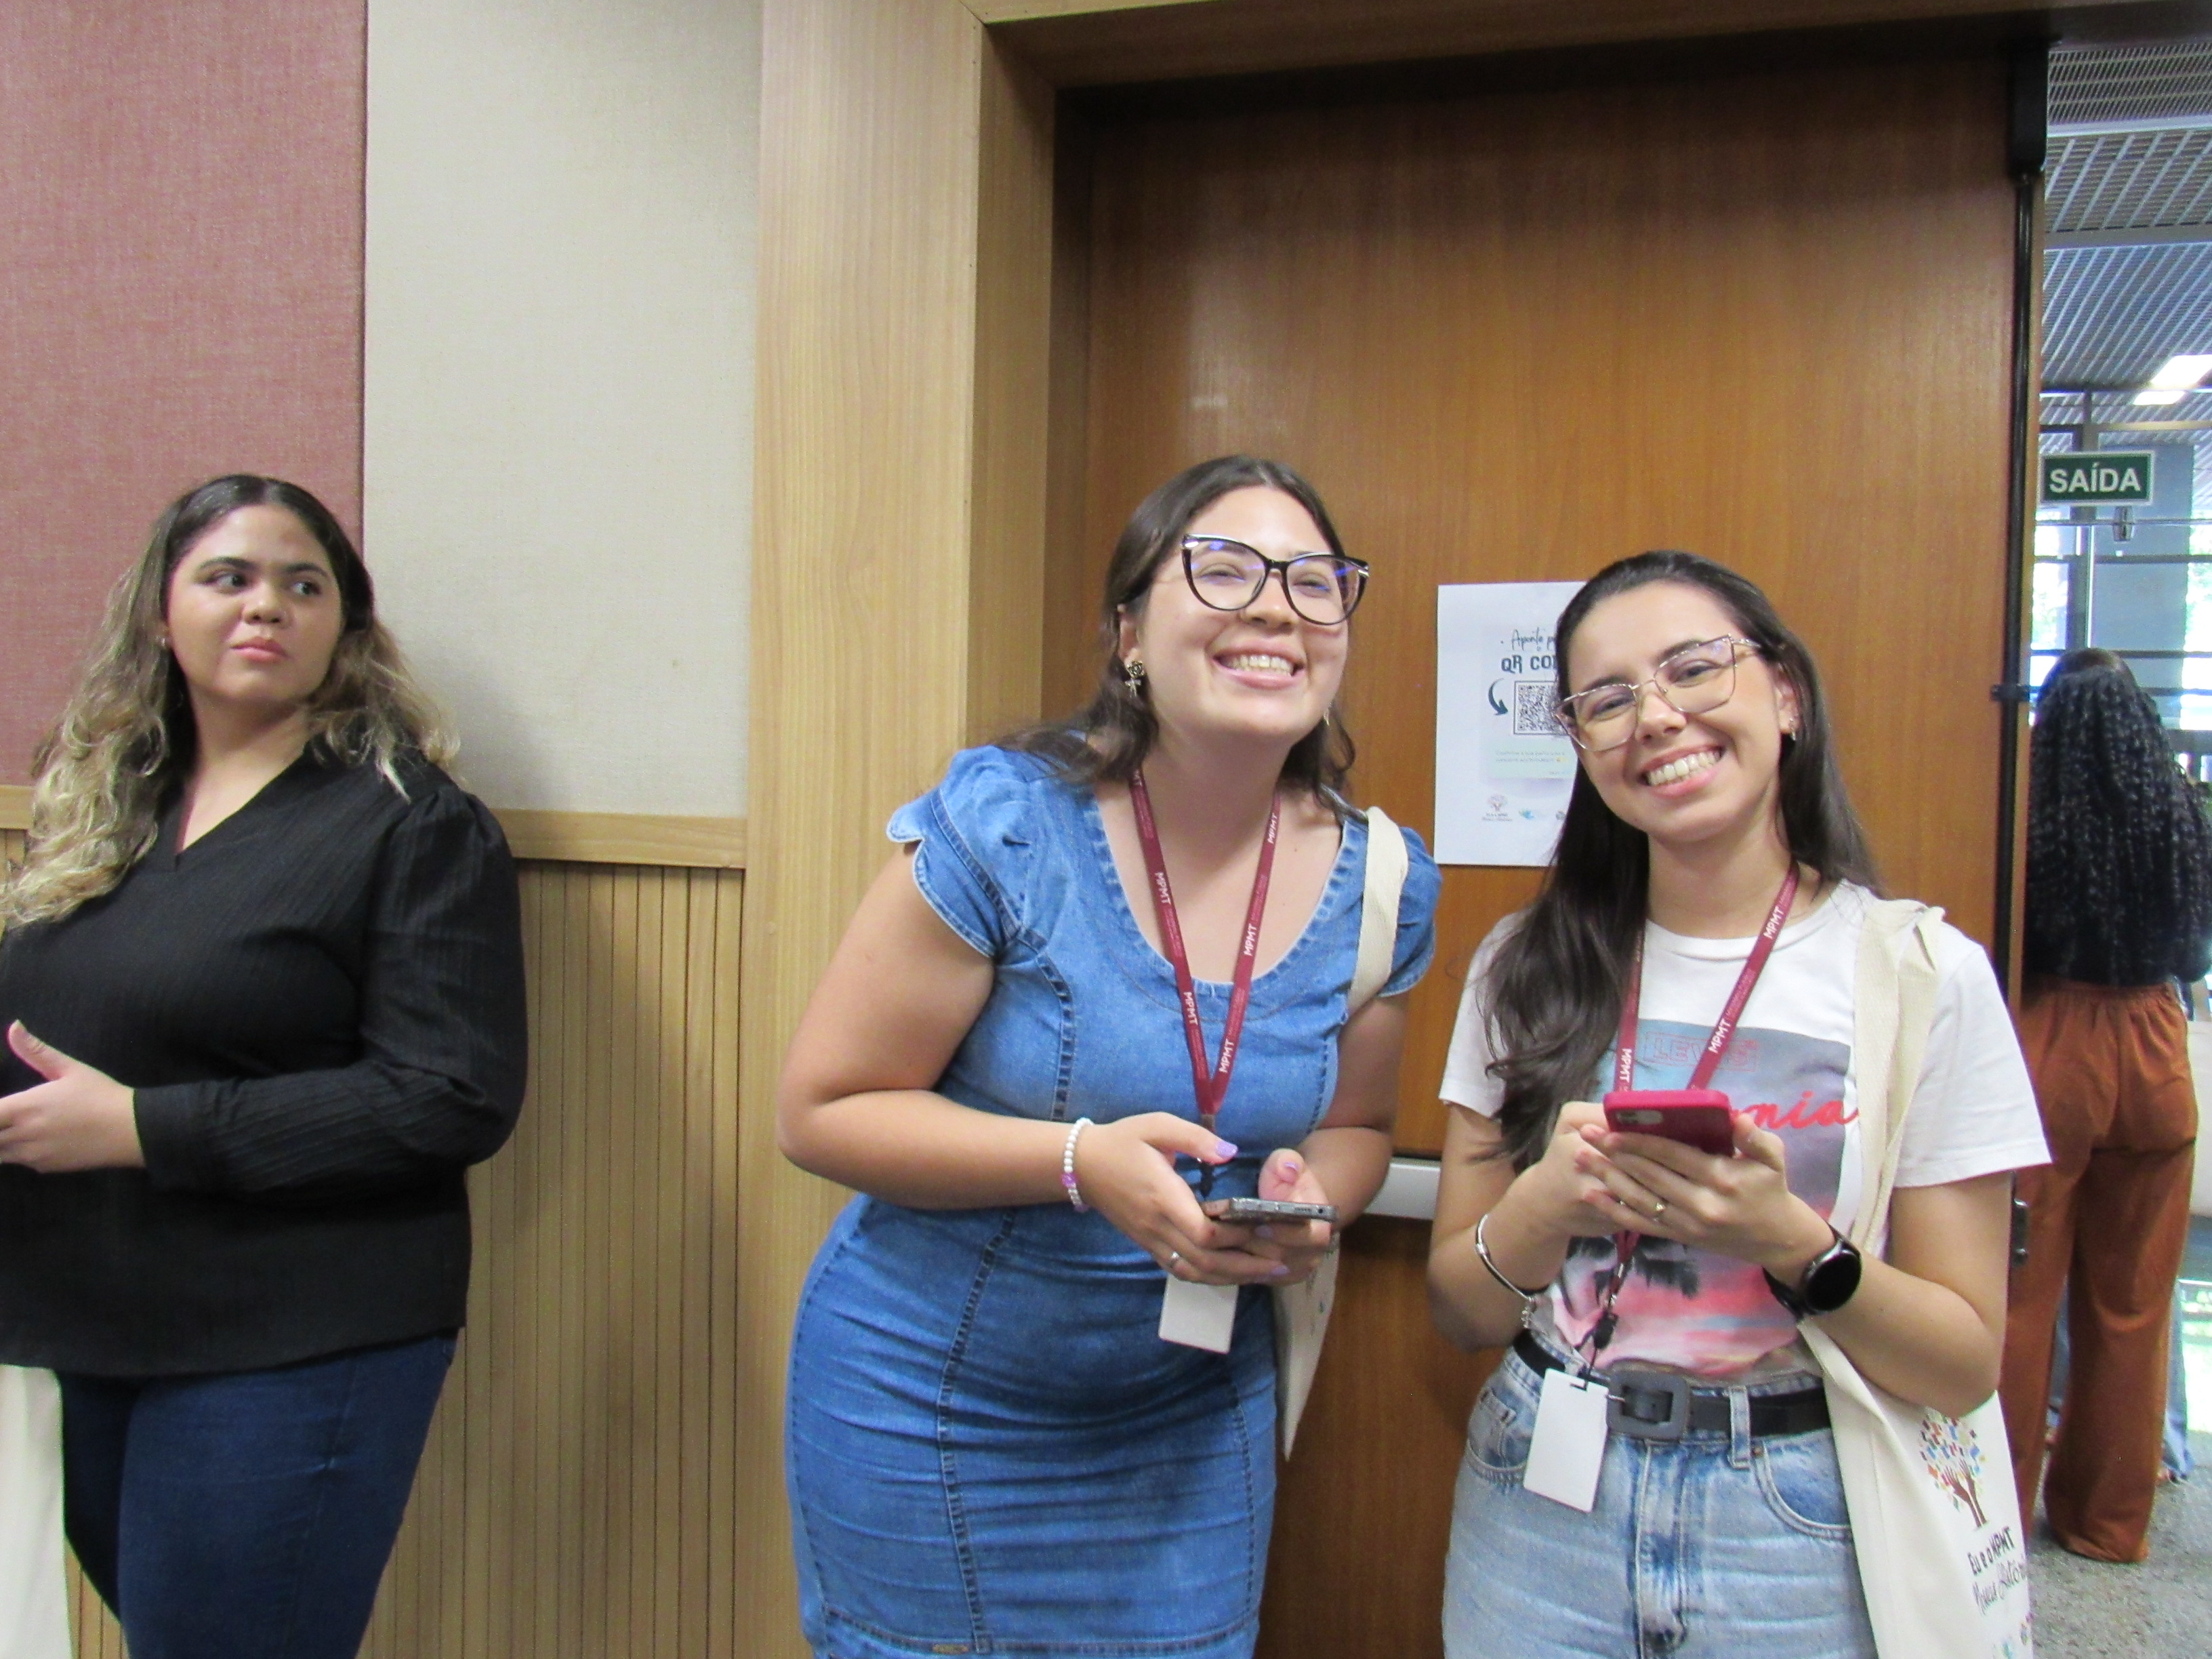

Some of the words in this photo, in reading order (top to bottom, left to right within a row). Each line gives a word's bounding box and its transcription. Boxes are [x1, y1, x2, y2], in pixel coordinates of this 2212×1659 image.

[2049, 462, 2141, 493] SAÍDA
[1501, 655, 1523, 674] QR
[1267, 813, 1278, 844] MPMT
[1155, 872, 1171, 905] MPMT
[1763, 905, 1784, 940] MPMT
[1244, 923, 1258, 957] MPMT
[1183, 991, 1198, 1026] MPMT
[1708, 1018, 1732, 1054] MPMT
[1219, 1038, 1234, 1073] MPMT
[1620, 1048, 1633, 1084] MPMT
